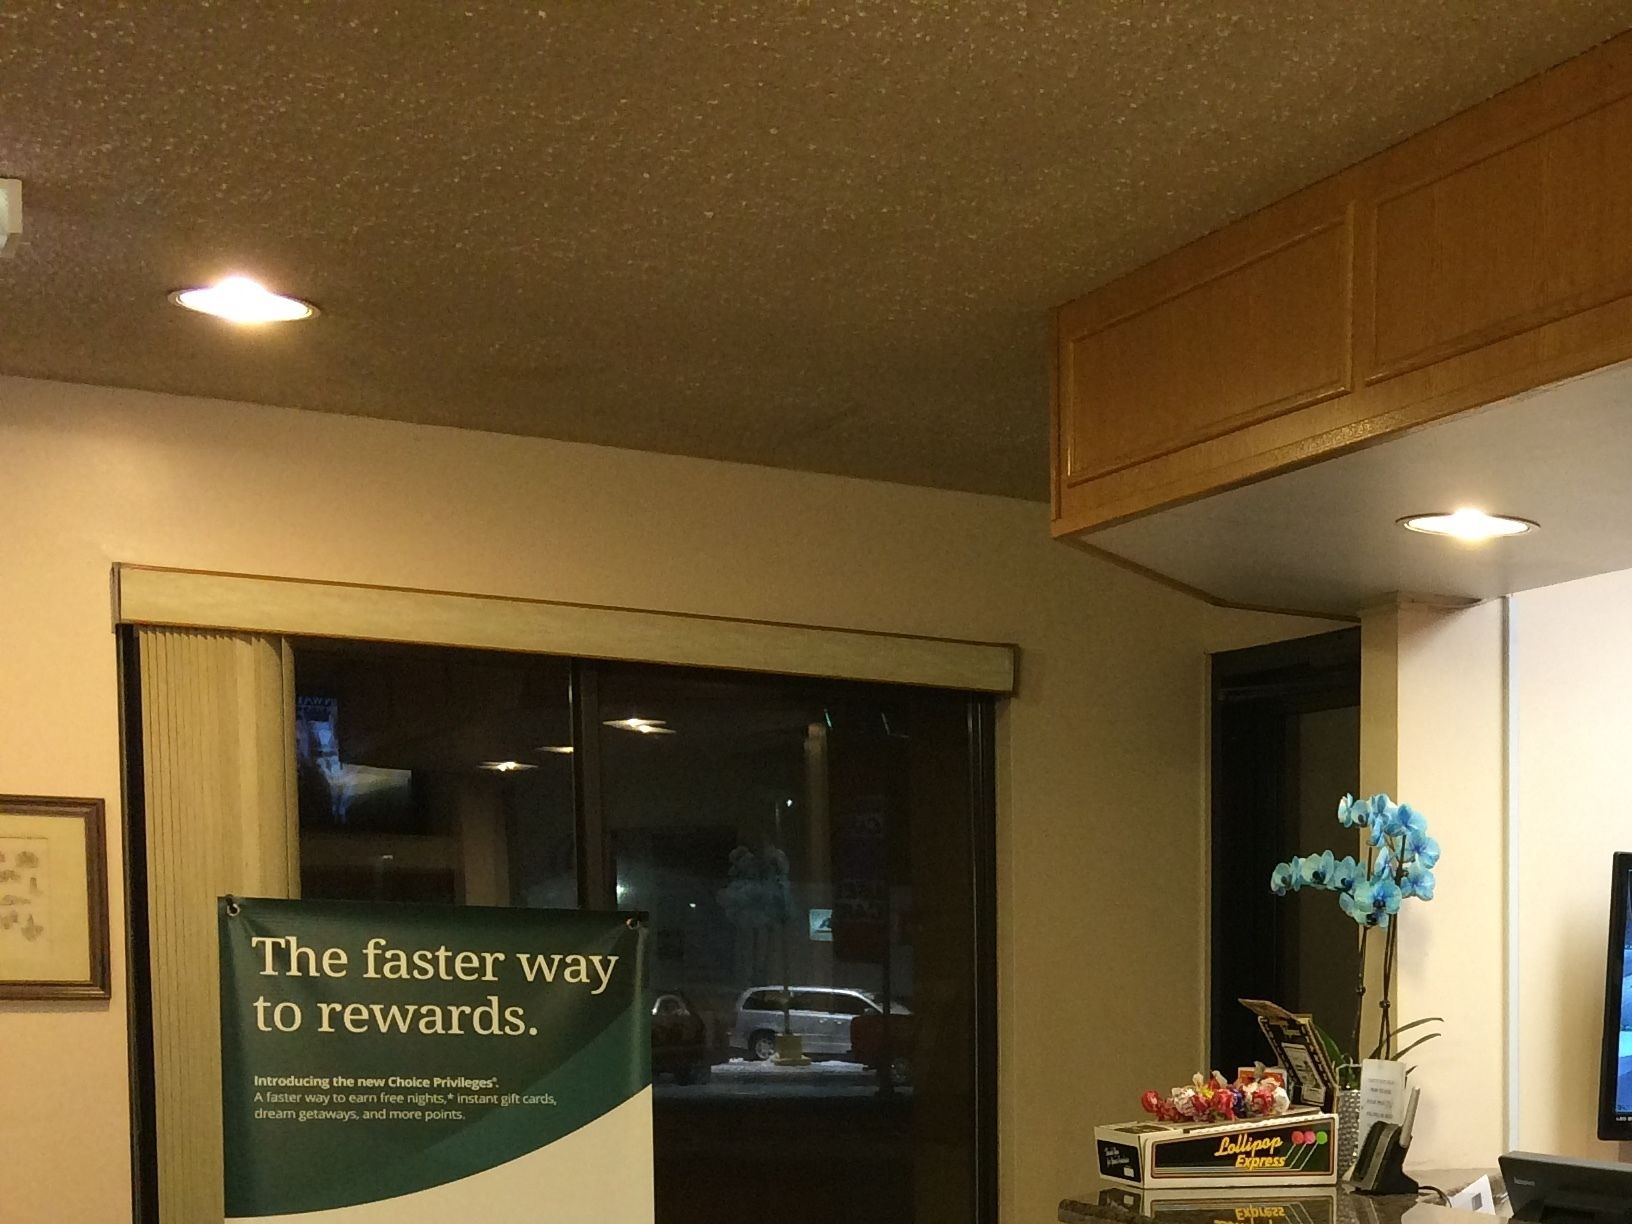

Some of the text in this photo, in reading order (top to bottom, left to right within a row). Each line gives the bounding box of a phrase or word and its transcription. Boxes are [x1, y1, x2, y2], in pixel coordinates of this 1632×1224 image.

[252, 936, 619, 995] The faster way
[253, 994, 538, 1037] to rewards.
[255, 1074, 330, 1090] Introducing
[333, 1075, 354, 1087] the
[358, 1078, 385, 1087] new
[388, 1075, 430, 1087] Choice
[254, 1091, 263, 1102] A
[267, 1091, 302, 1102] faster
[305, 1094, 330, 1106] way
[333, 1091, 346, 1102] to
[349, 1094, 377, 1103] earn
[380, 1091, 404, 1103] free
[458, 1092, 498, 1103] instant
[501, 1092, 520, 1107] gift
[523, 1092, 556, 1107] cards,
[255, 1107, 465, 1122] dream getaways, and more points.
[1214, 1133, 1283, 1157] Lollipop
[1235, 1154, 1287, 1171] Express
